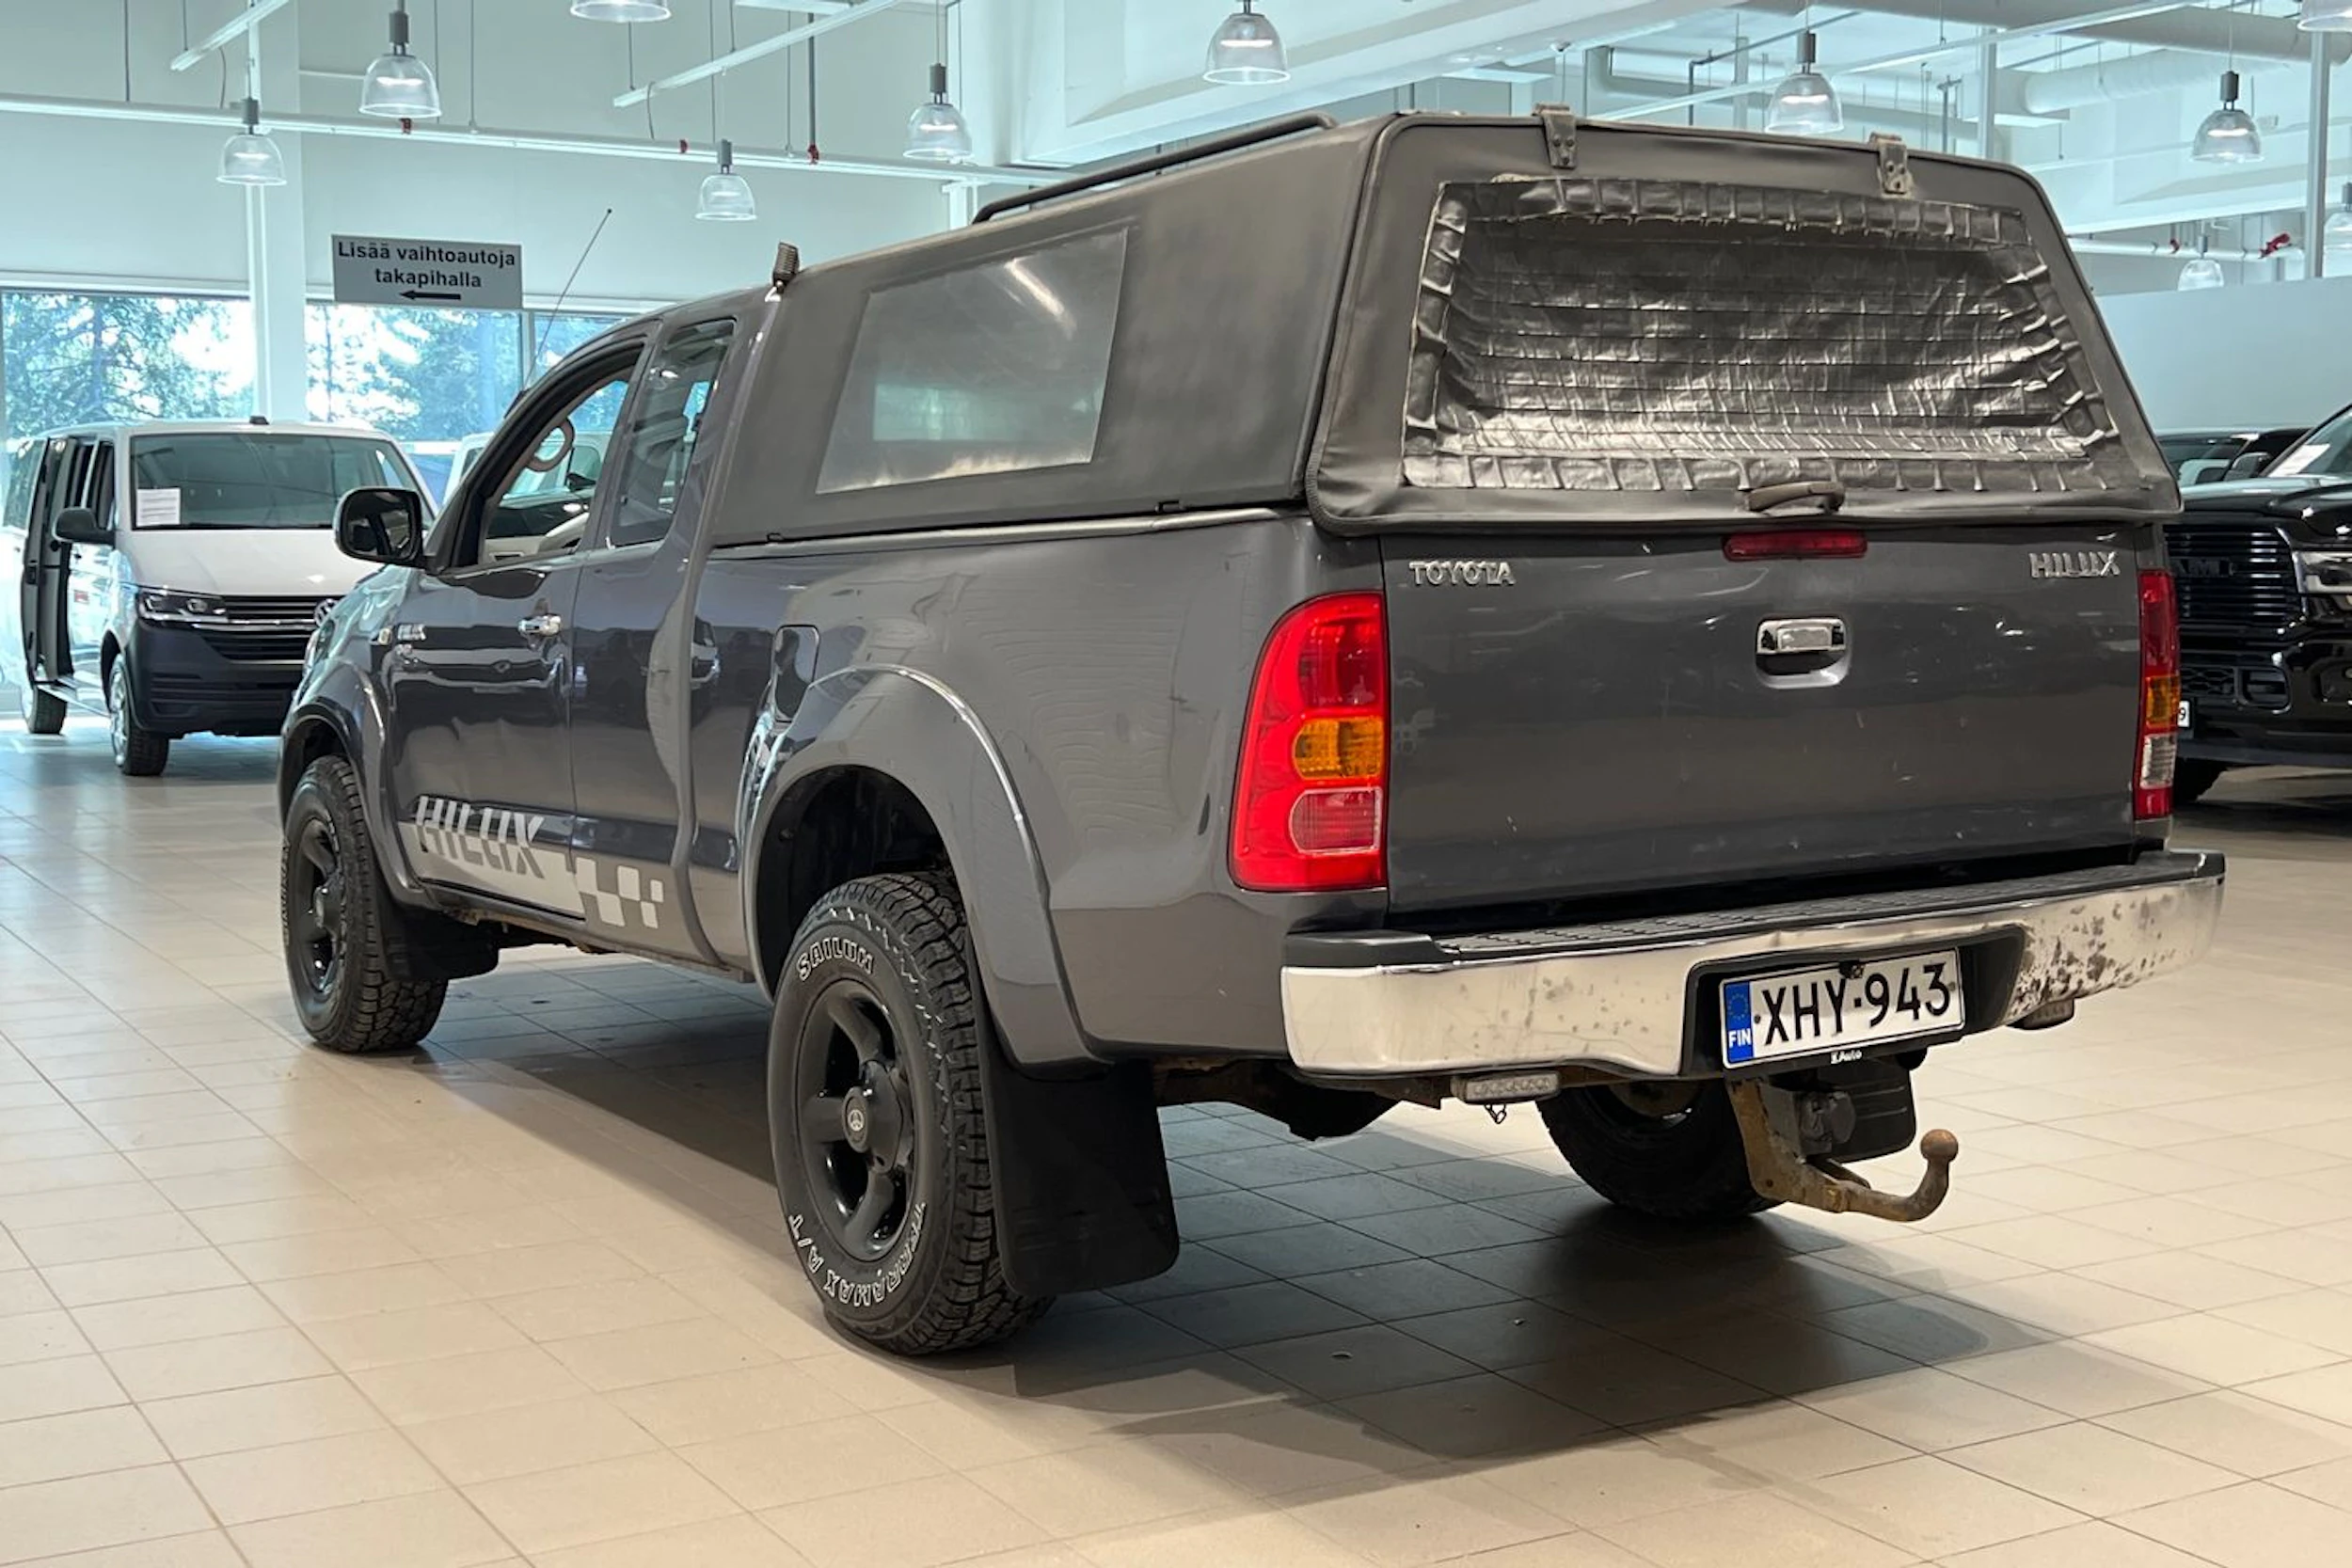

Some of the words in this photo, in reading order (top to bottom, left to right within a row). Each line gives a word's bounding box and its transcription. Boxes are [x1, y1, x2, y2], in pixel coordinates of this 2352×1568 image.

[338, 242, 390, 260] Lisää
[396, 245, 516, 269] vaihtoautoja
[375, 268, 482, 289] takapihalla
[1409, 561, 1517, 585] TOYOTA
[2029, 551, 2121, 578] HILUX
[416, 796, 546, 879] HILUX
[796, 936, 873, 981] SAILUN
[1728, 1029, 1752, 1049] FIN
[1761, 961, 1951, 1046] XHY-943
[787, 1213, 825, 1275] A/T
[822, 1202, 927, 1307] TERRAMAX
